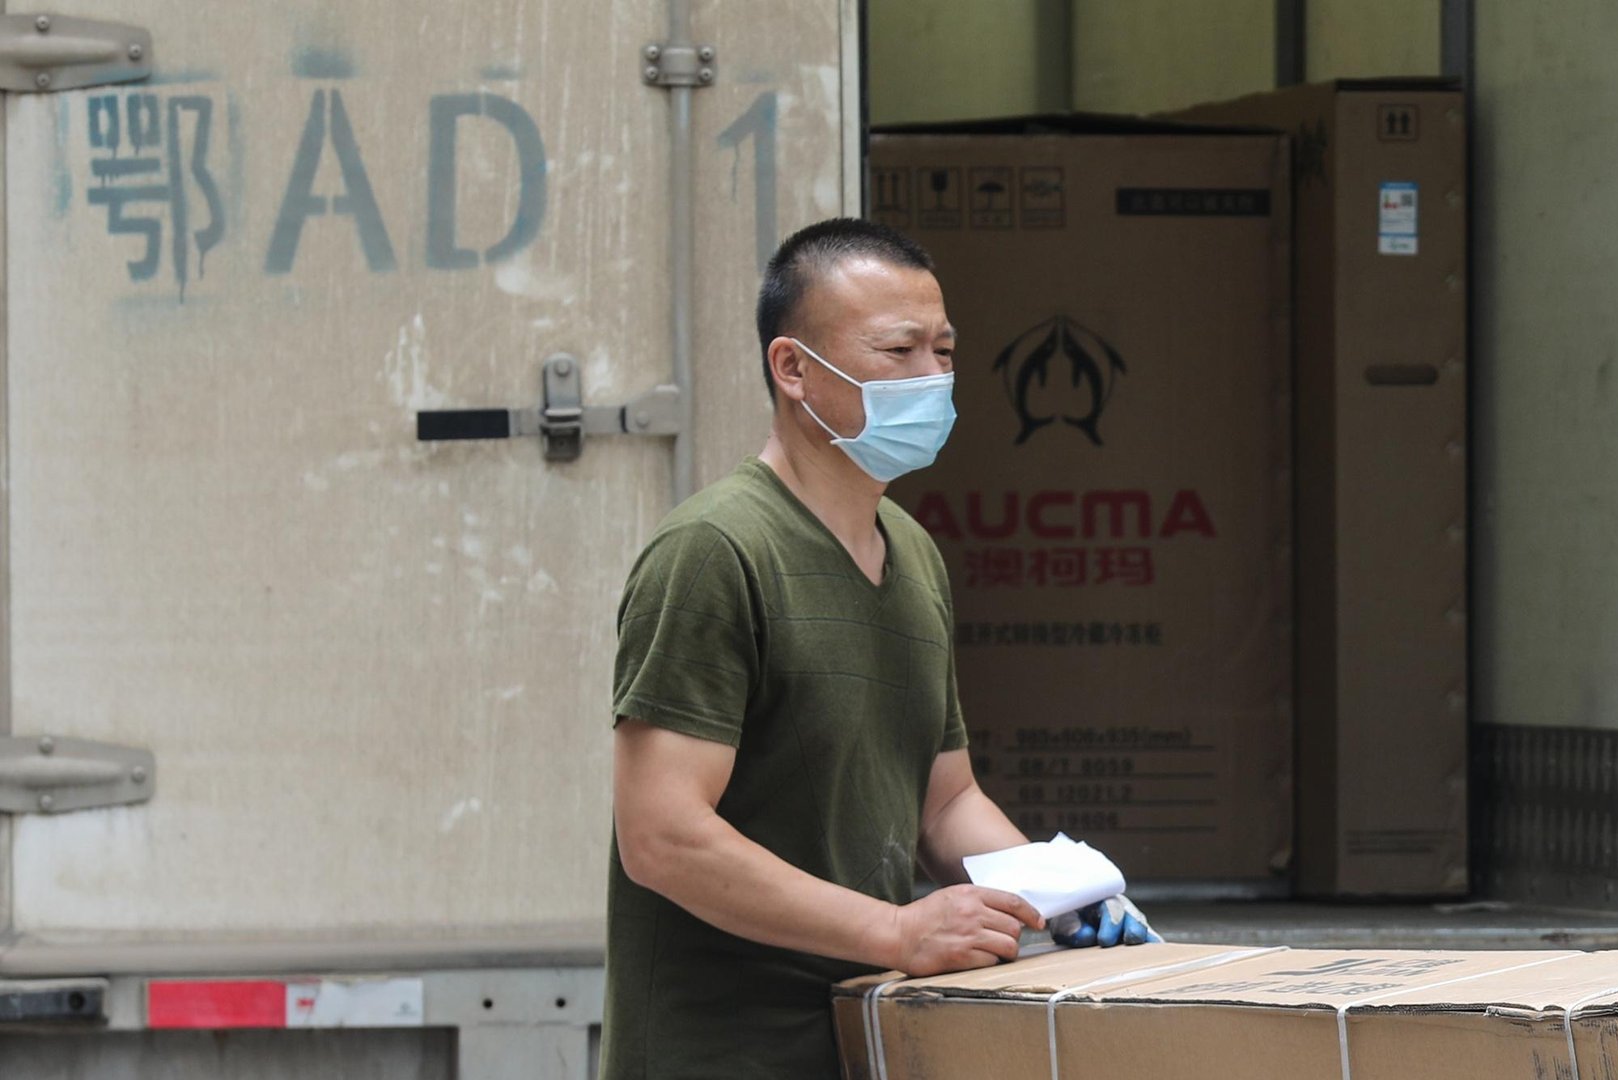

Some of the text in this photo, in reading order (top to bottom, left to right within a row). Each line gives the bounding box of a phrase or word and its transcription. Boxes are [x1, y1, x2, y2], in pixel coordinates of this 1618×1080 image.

[915, 488, 1216, 540] AUCMA
[964, 546, 1156, 589] 澳柯玛
